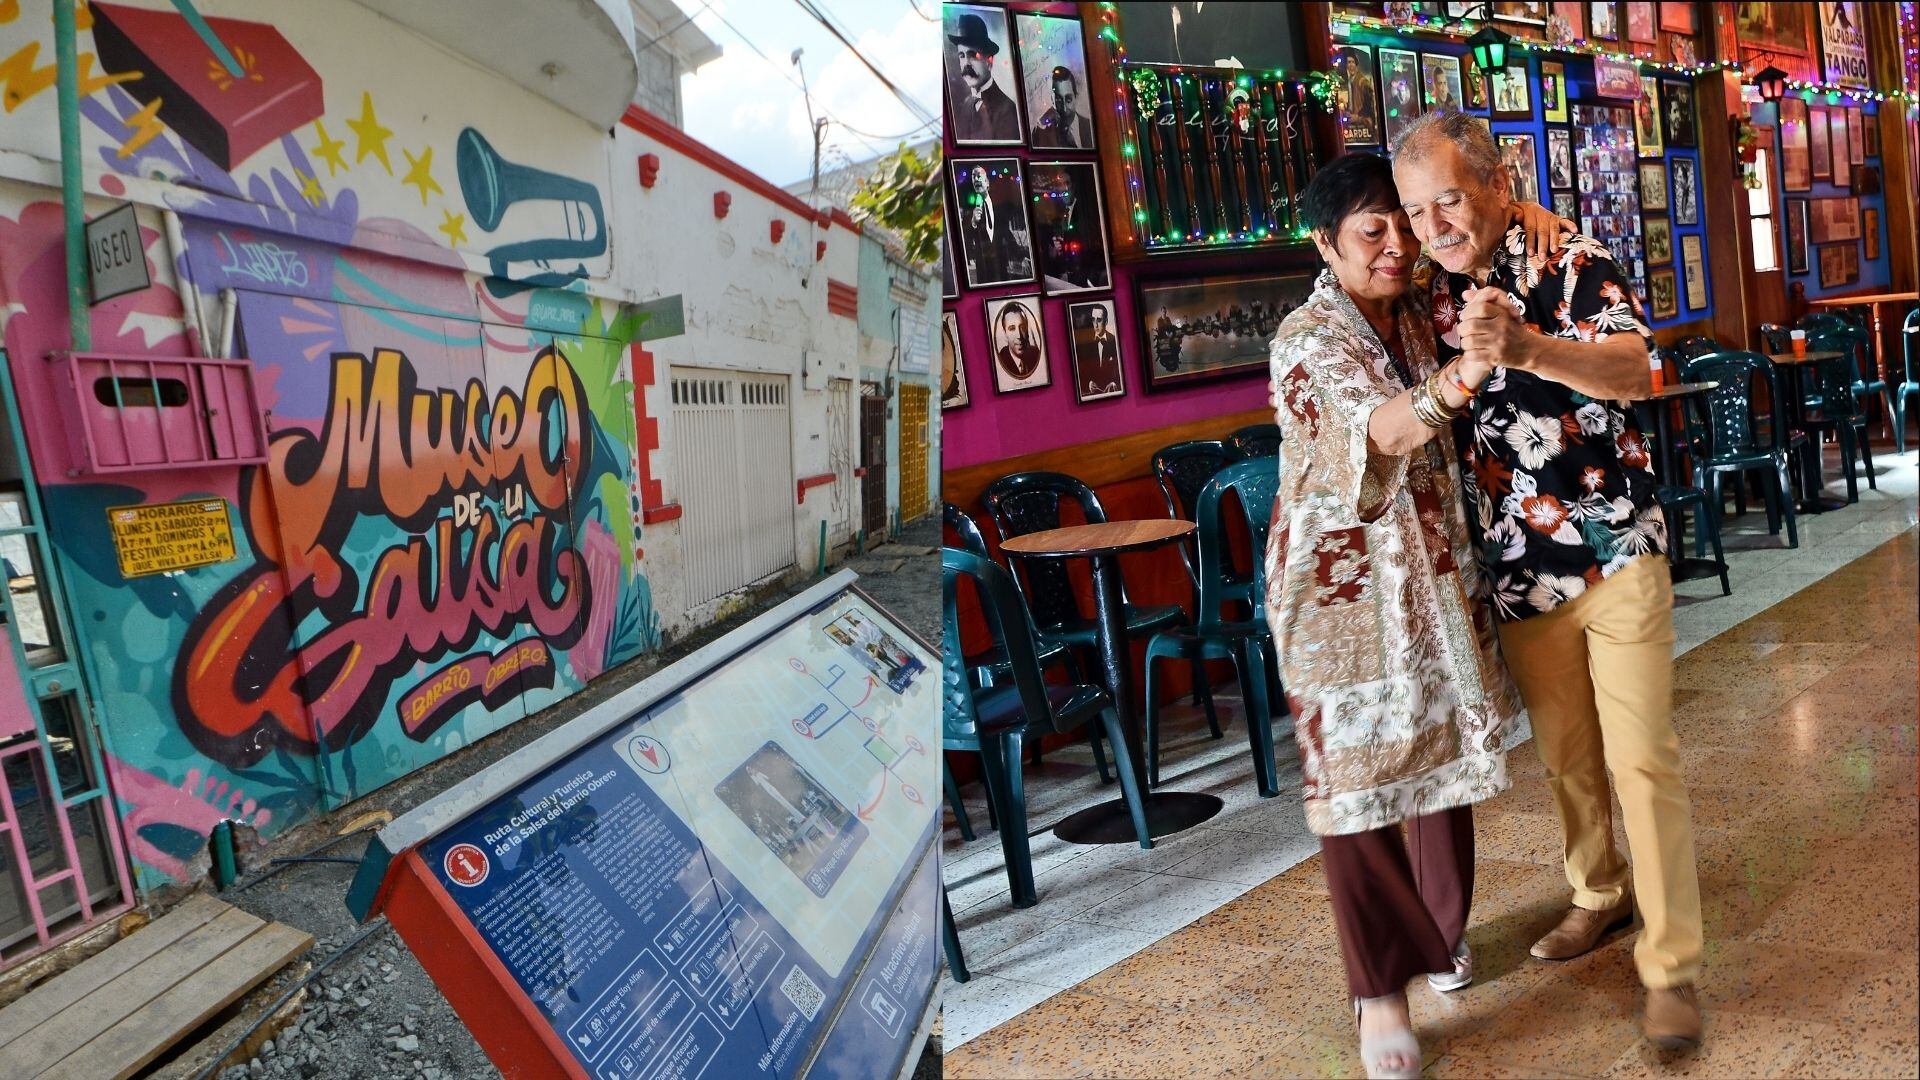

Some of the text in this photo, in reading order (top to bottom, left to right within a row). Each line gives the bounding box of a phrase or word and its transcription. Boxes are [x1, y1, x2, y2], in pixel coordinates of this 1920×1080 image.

[1826, 52, 1866, 78] TANGO
[92, 229, 132, 274] USEO
[138, 504, 205, 520] HORARIOS
[454, 483, 524, 529] DE LA
[116, 522, 152, 536] LUNES
[154, 522, 162, 532] A
[162, 516, 206, 530] SABADOS
[120, 538, 126, 548] A
[156, 528, 206, 544] DOMINGOS
[208, 526, 216, 538] Y
[123, 545, 174, 562] FESTIVOS
[200, 541, 206, 551] A
[158, 558, 176, 568] VIVA
[179, 555, 190, 564] LA
[412, 648, 544, 722] BARRIO OBRERO
[636, 738, 650, 750] N
[482, 768, 594, 845] Ruta Cultural y Turística
[491, 767, 617, 856] de la Salsa del barrio Obrero
[472, 904, 486, 916] Esta
[484, 896, 496, 908] ruta
[494, 883, 514, 900] cultural
[478, 905, 500, 923] conocer
[484, 911, 508, 931] recorrido
[495, 908, 524, 934] importancia
[511, 911, 535, 932] desarrollo
[678, 912, 694, 929] Centro
[501, 934, 524, 954] Algunos
[507, 946, 522, 961] parte
[526, 932, 539, 945] esta
[718, 928, 731, 944] Santa
[878, 938, 906, 984] Atractivo
[898, 908, 921, 945] cultural
[513, 950, 533, 969] Parque
[530, 941, 543, 954] Eloy
[524, 954, 543, 972] parque
[891, 961, 912, 996] Cultural
[905, 930, 926, 967] attraction
[599, 966, 645, 1018] Parque Eloy Alfaro
[607, 1013, 617, 1025] 300
[627, 989, 682, 1053] Terminal de transporte
[642, 1042, 652, 1054] km
[671, 1032, 695, 1063] Artesanal
[756, 1008, 798, 1072] Más información
[772, 1018, 807, 1073] More information
[674, 1042, 700, 1075] de la Cruz
